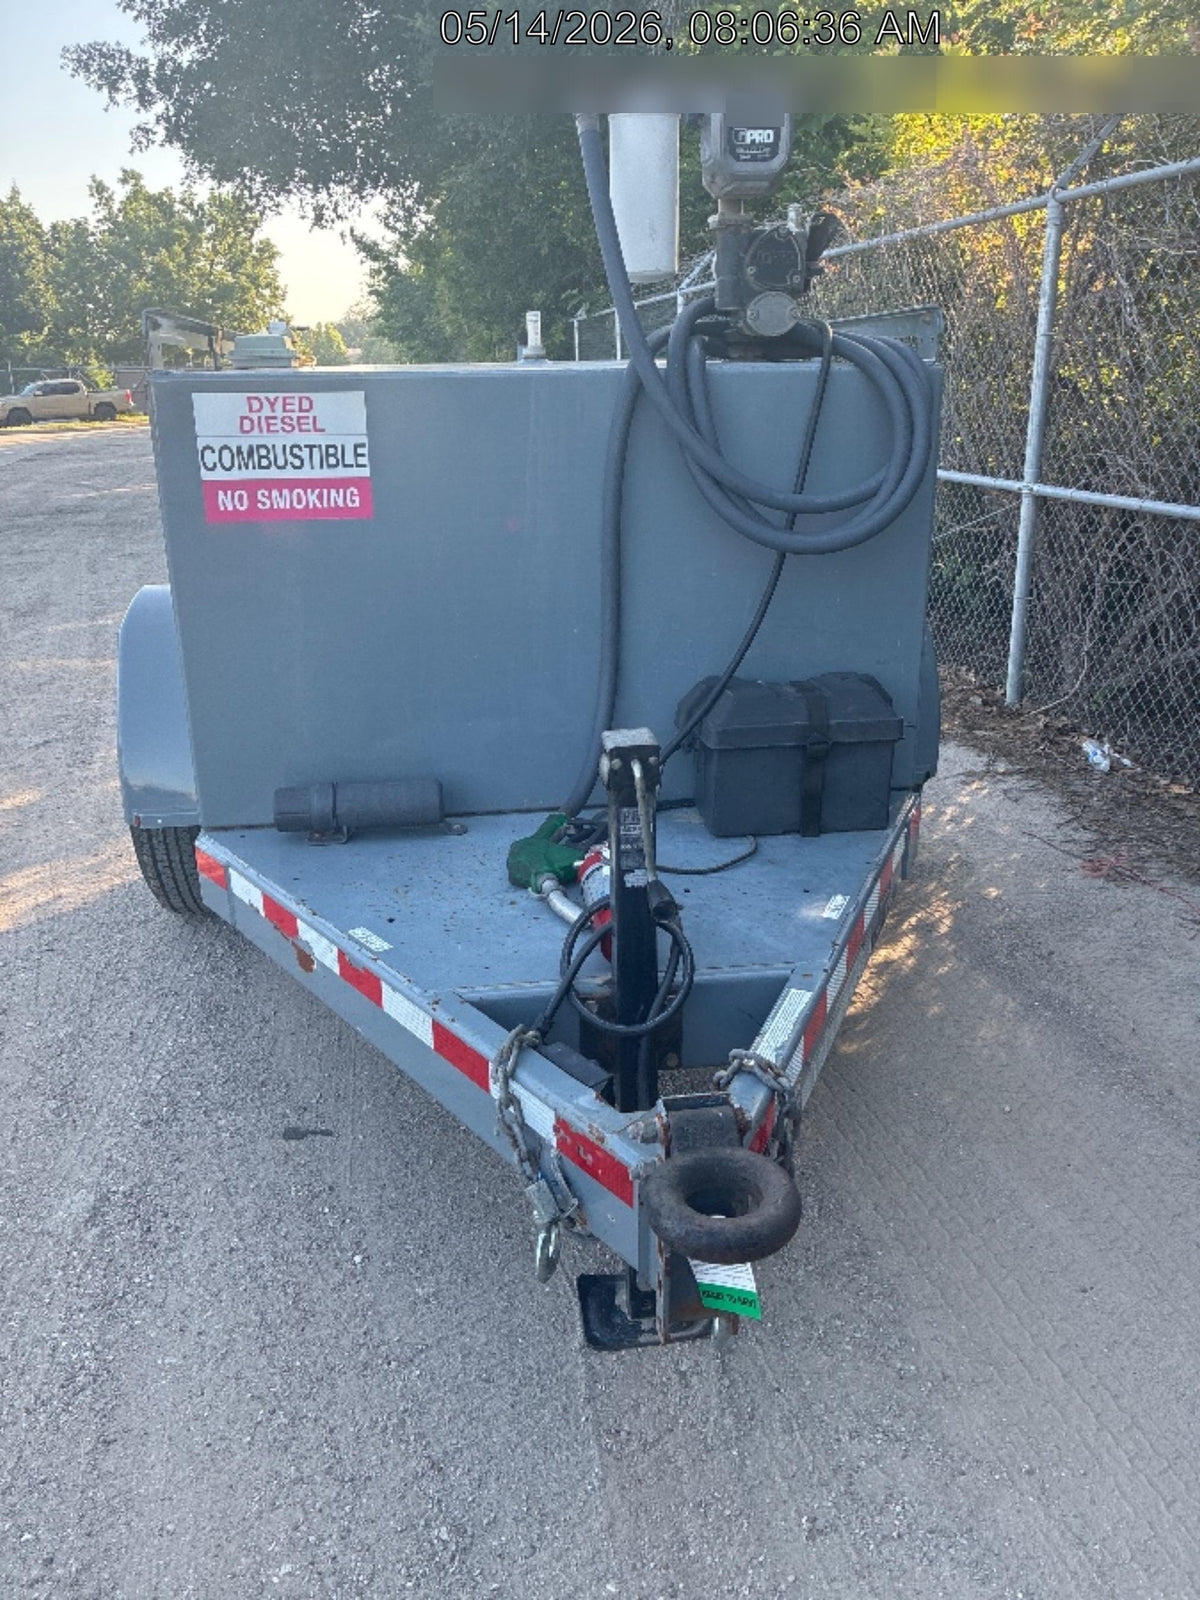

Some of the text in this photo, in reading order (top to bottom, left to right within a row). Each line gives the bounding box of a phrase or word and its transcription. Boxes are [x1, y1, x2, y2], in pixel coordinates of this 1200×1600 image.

[246, 396, 314, 413] DYED
[239, 415, 326, 434] DIESEL
[200, 442, 368, 472] COMBUSTIBLE
[217, 486, 360, 511] NO SMOKING
